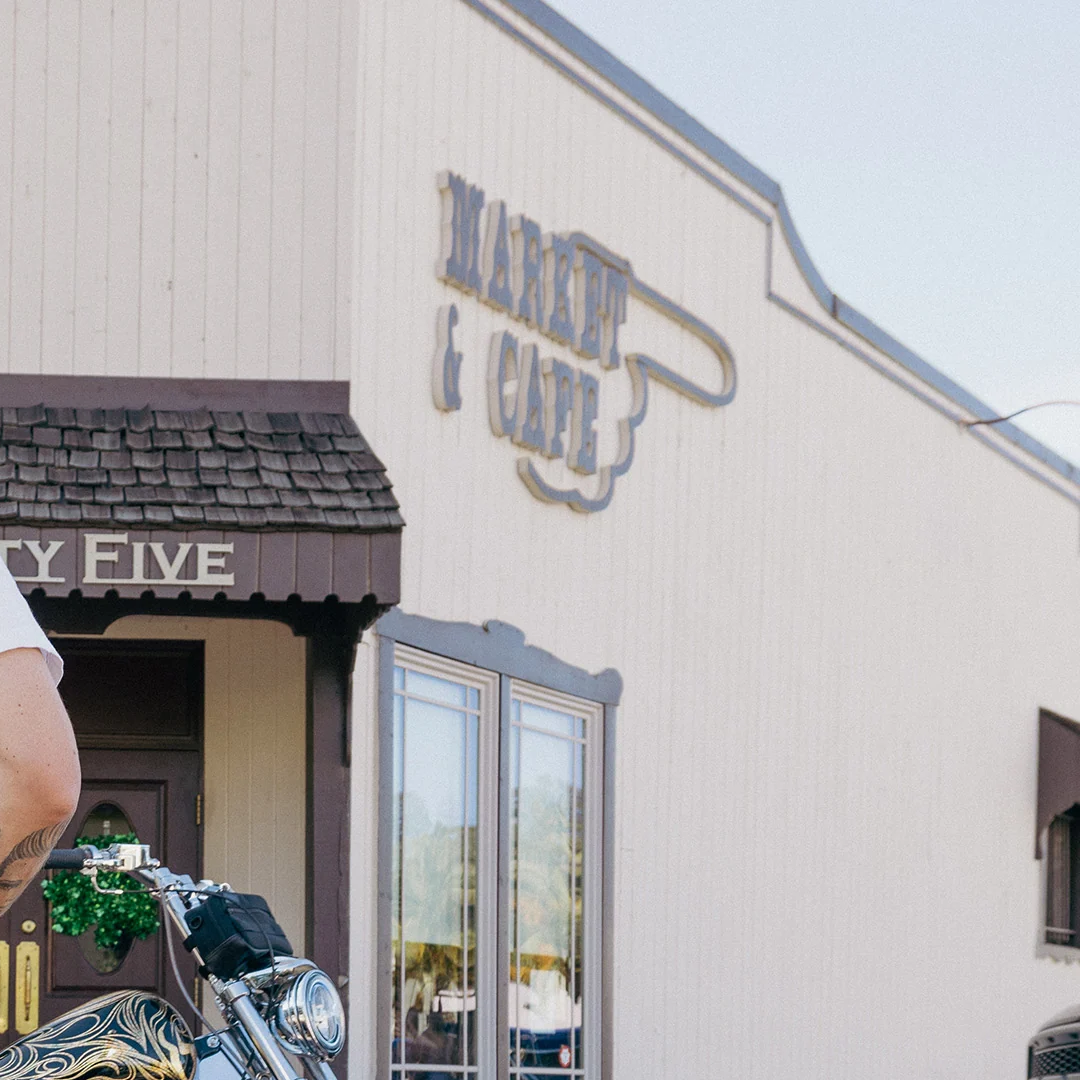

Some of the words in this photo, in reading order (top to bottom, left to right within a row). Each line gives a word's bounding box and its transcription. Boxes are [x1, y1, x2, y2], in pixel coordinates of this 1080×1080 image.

[435, 169, 626, 371] MARKET
[486, 330, 600, 475] CAFE
[82, 532, 235, 586] FIVE
